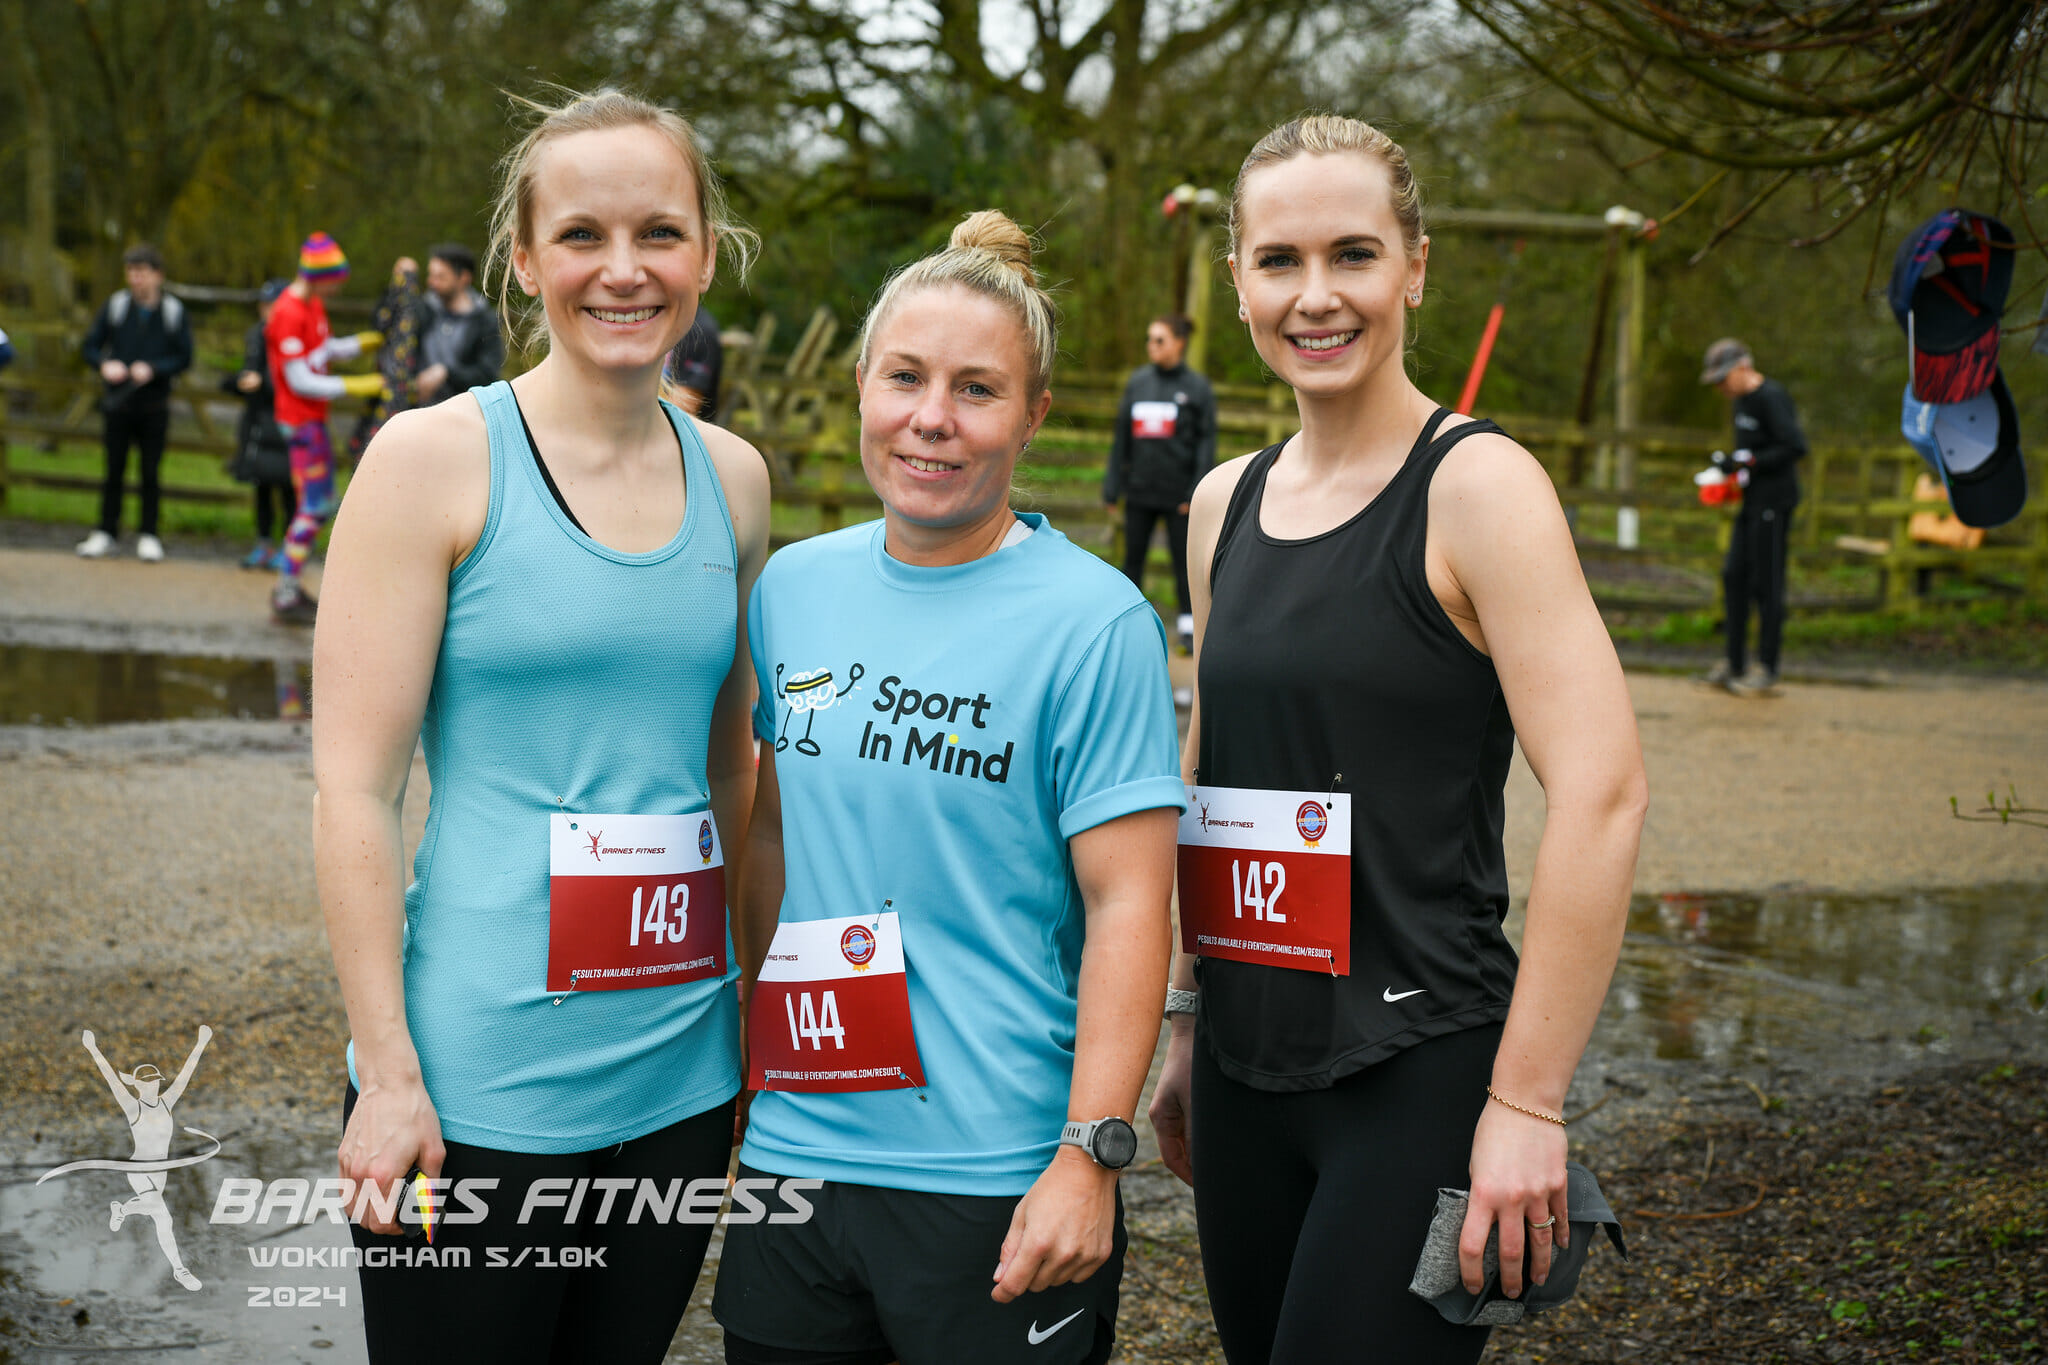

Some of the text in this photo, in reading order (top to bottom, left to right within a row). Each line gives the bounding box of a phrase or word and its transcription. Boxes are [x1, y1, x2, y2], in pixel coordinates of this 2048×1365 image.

[872, 675, 992, 729] Sport
[858, 720, 1015, 784] In Mind
[1207, 819, 1254, 829] BARNES FITNESS
[602, 847, 666, 855] BARNES FITNESS
[1231, 859, 1287, 923] 142
[629, 883, 690, 947] 143
[1218, 937, 1242, 948] AVAILABLE
[1247, 941, 1332, 958] EVENTCHIPTIMING.COM/RESULTS
[602, 967, 636, 978] AVAILABLE
[636, 967, 642, 977] @
[785, 990, 846, 1051] 144
[810, 1066, 901, 1080] EVENTCHIPTIMING.COM/RESULTS
